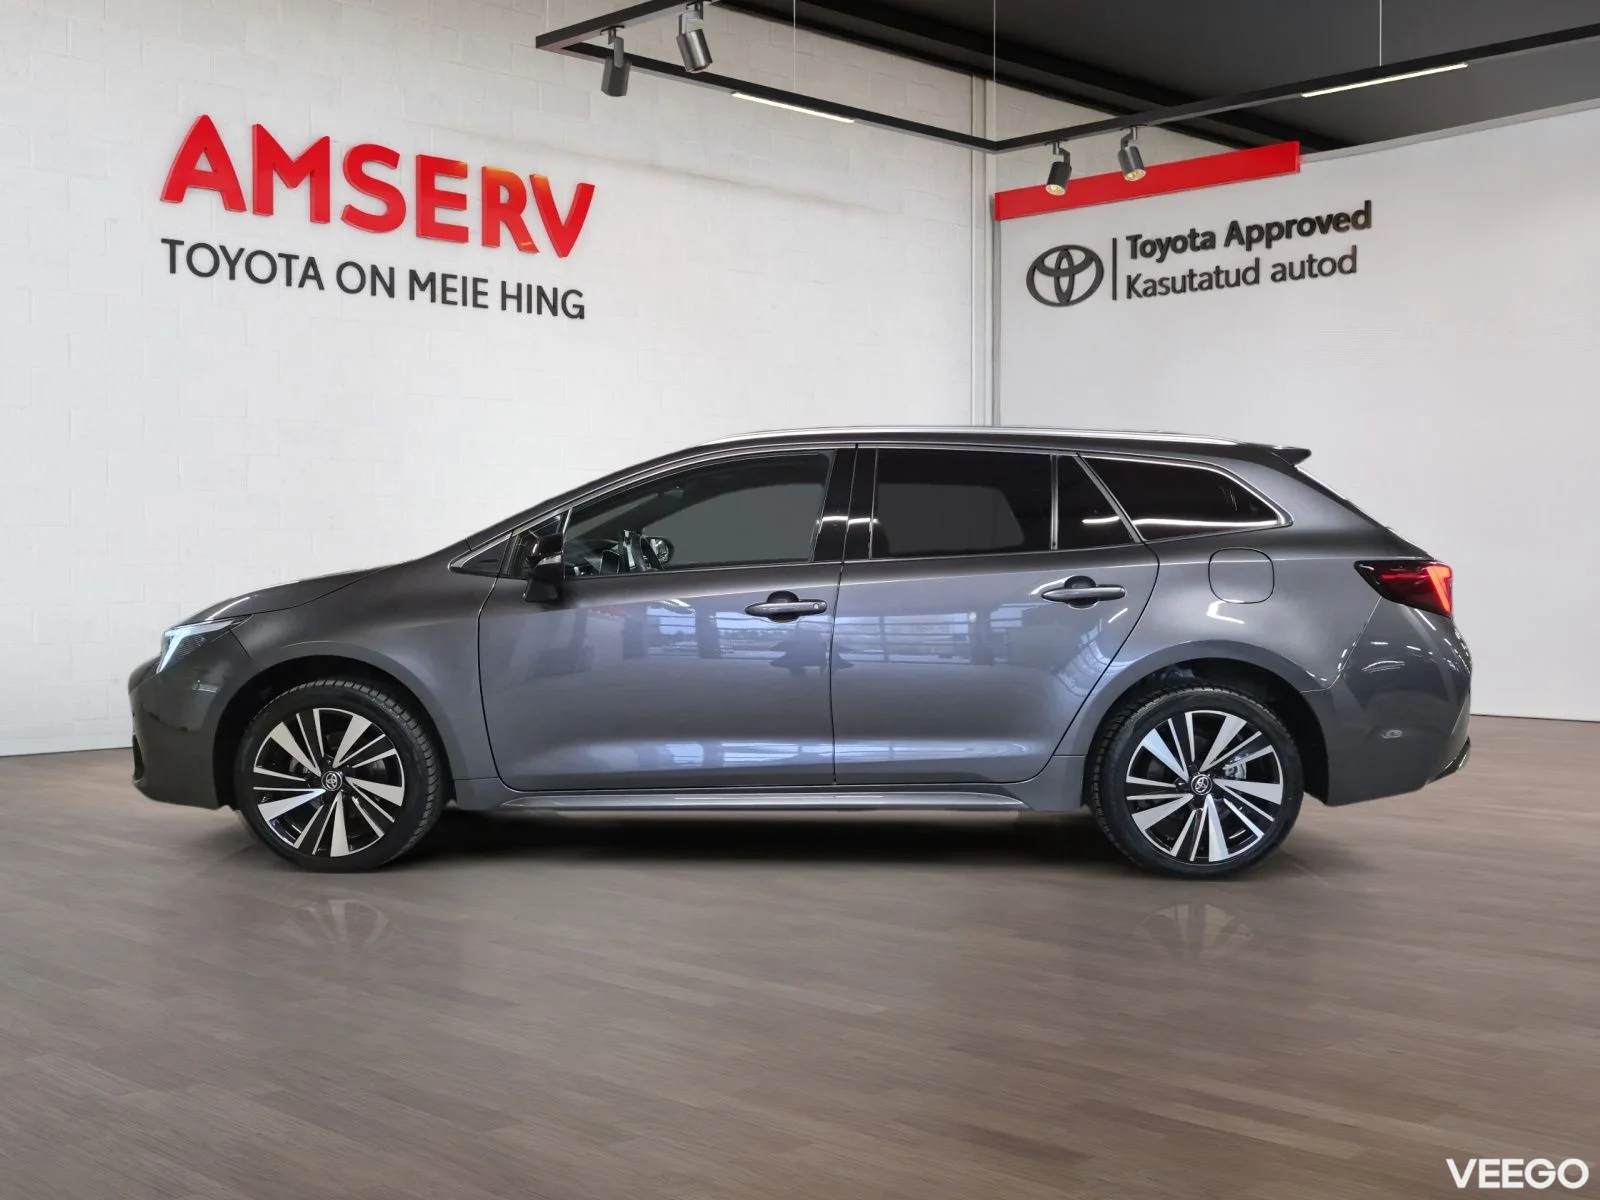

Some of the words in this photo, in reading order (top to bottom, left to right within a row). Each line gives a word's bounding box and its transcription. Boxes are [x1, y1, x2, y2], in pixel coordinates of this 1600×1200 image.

[160, 114, 596, 258] AMSERV
[1125, 227, 1217, 264] Toyota
[1224, 199, 1373, 254] Approved
[160, 238, 325, 291] TOYOTA
[335, 260, 396, 299] ON
[408, 269, 490, 309] MEIE
[500, 280, 586, 320] HING
[1125, 256, 1261, 300] Kasutatud
[1270, 245, 1358, 284] autod
